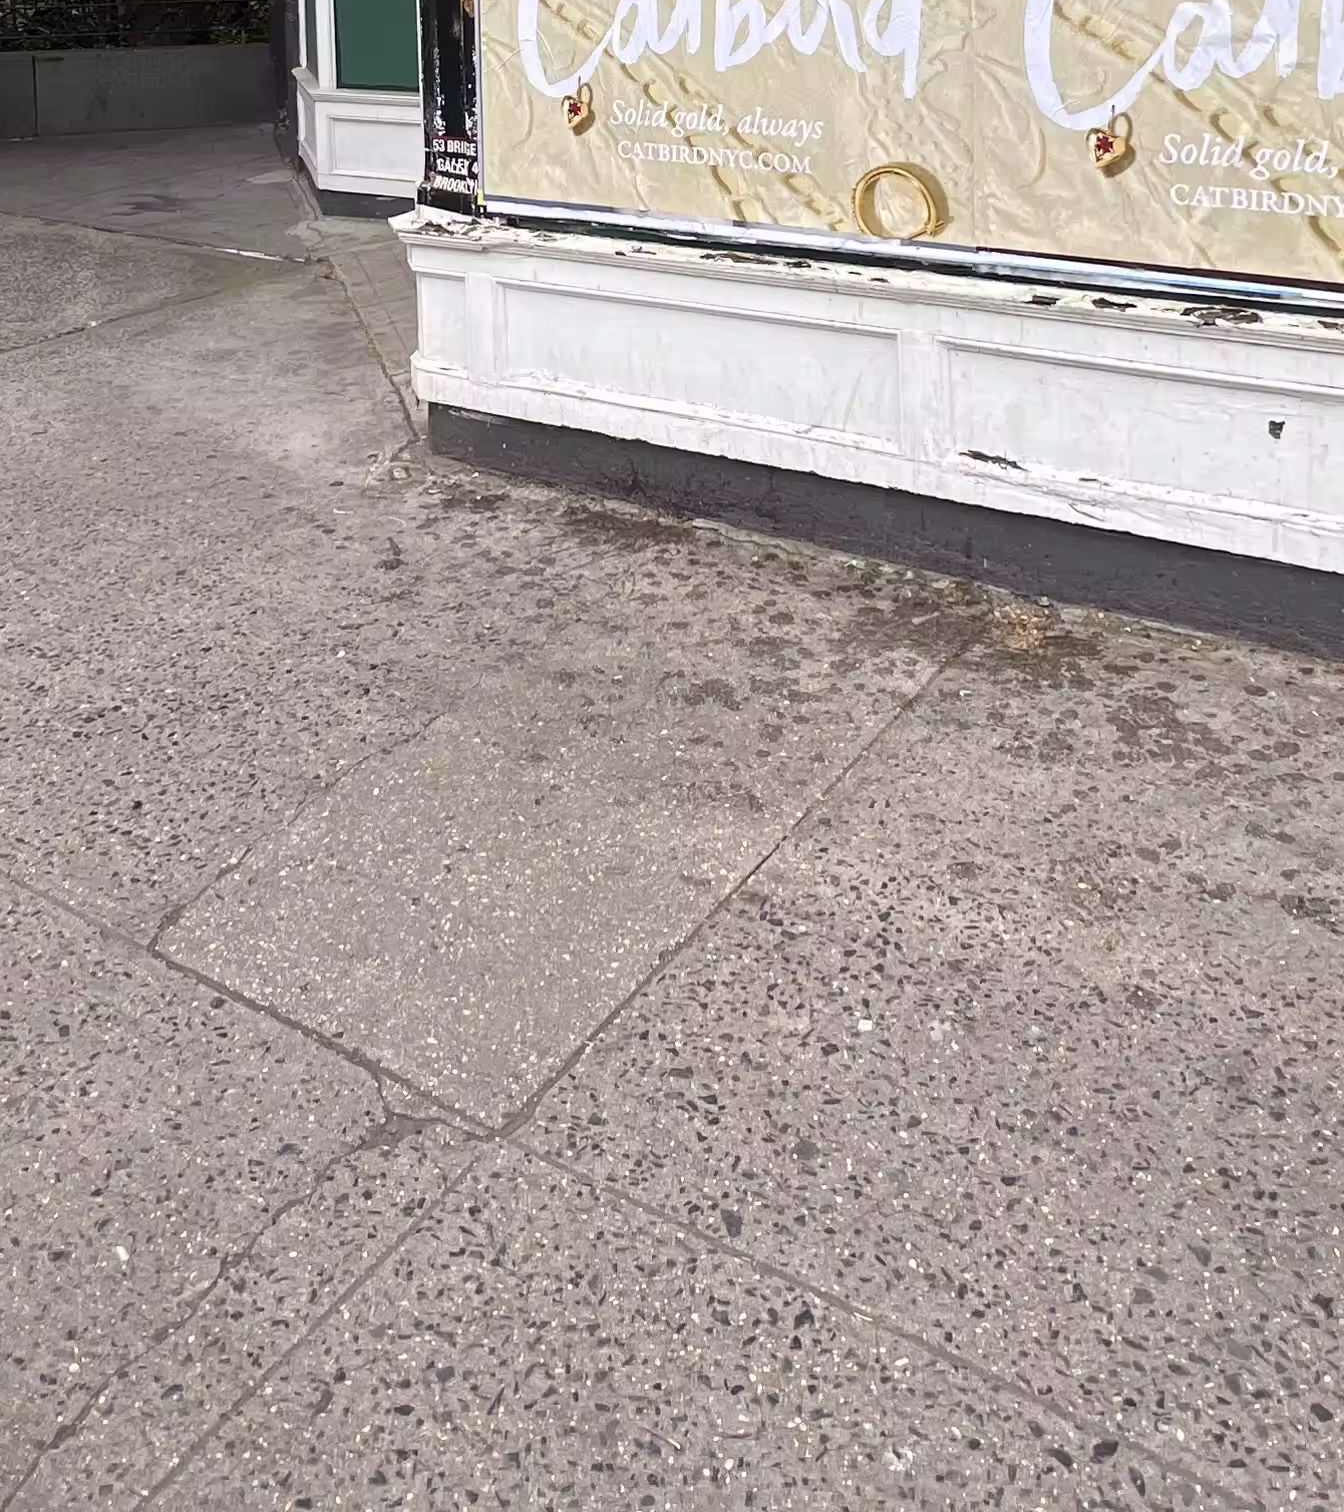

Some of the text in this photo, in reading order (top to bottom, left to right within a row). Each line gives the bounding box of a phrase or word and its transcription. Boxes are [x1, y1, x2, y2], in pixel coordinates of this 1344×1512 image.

[610, 99, 825, 148] Solid gold, always
[433, 139, 446, 152] 53
[618, 140, 812, 174] CATBIRDNYC.COM
[1159, 134, 1245, 167] Solid
[1249, 139, 1338, 181] gold,
